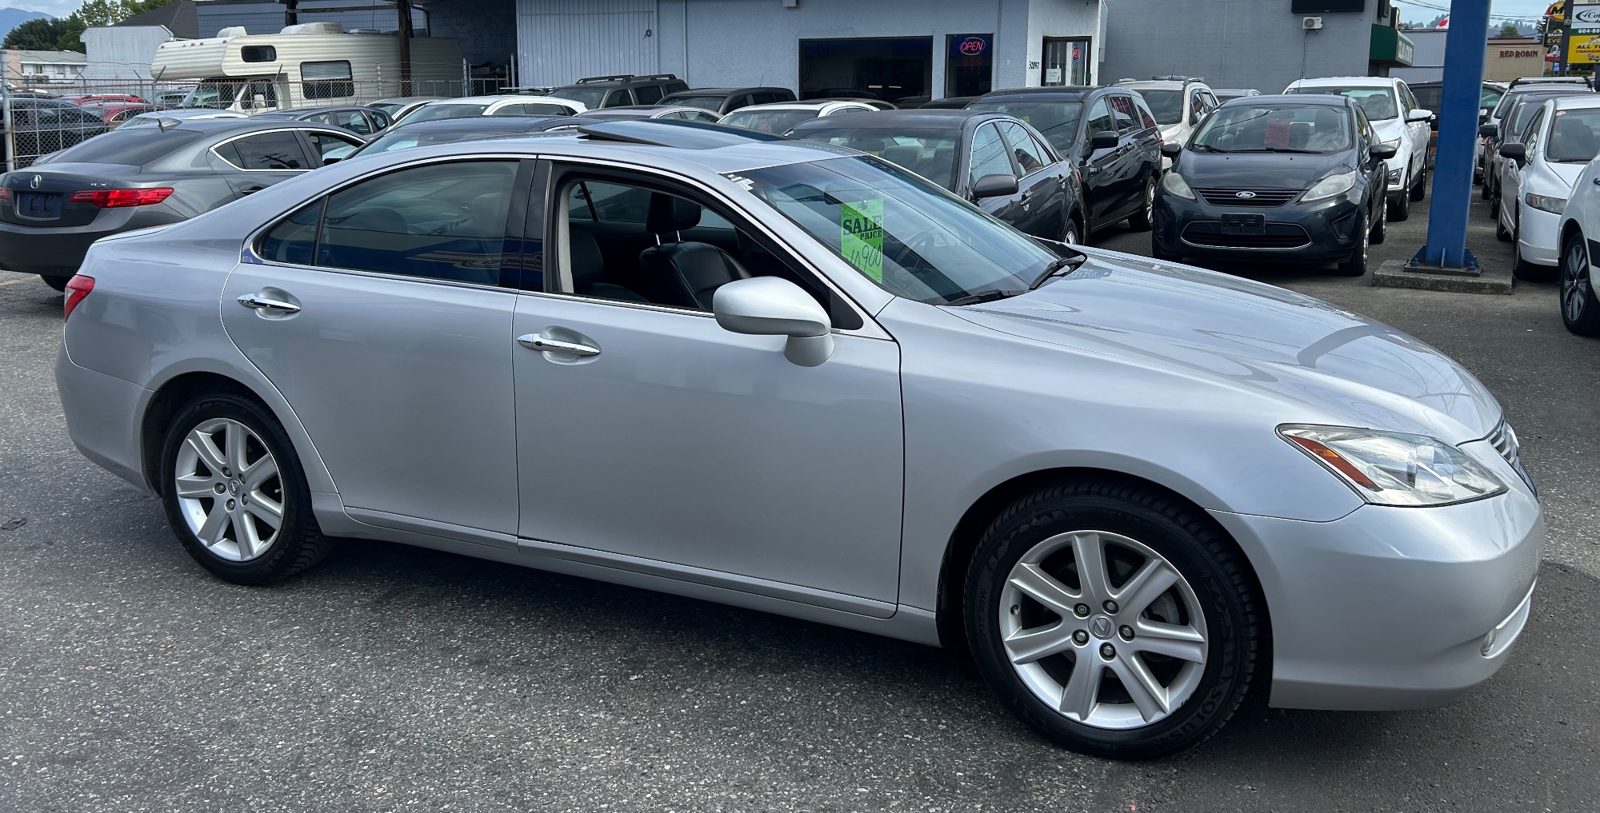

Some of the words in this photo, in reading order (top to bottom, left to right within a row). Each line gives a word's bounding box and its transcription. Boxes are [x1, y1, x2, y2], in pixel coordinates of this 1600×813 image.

[961, 41, 983, 51] OPEN
[1500, 50, 1515, 58] RED
[1515, 50, 1539, 58] ROBIN
[843, 215, 882, 234] SALE
[860, 230, 882, 240] PRICE
[1169, 687, 1223, 741] SOLUS
